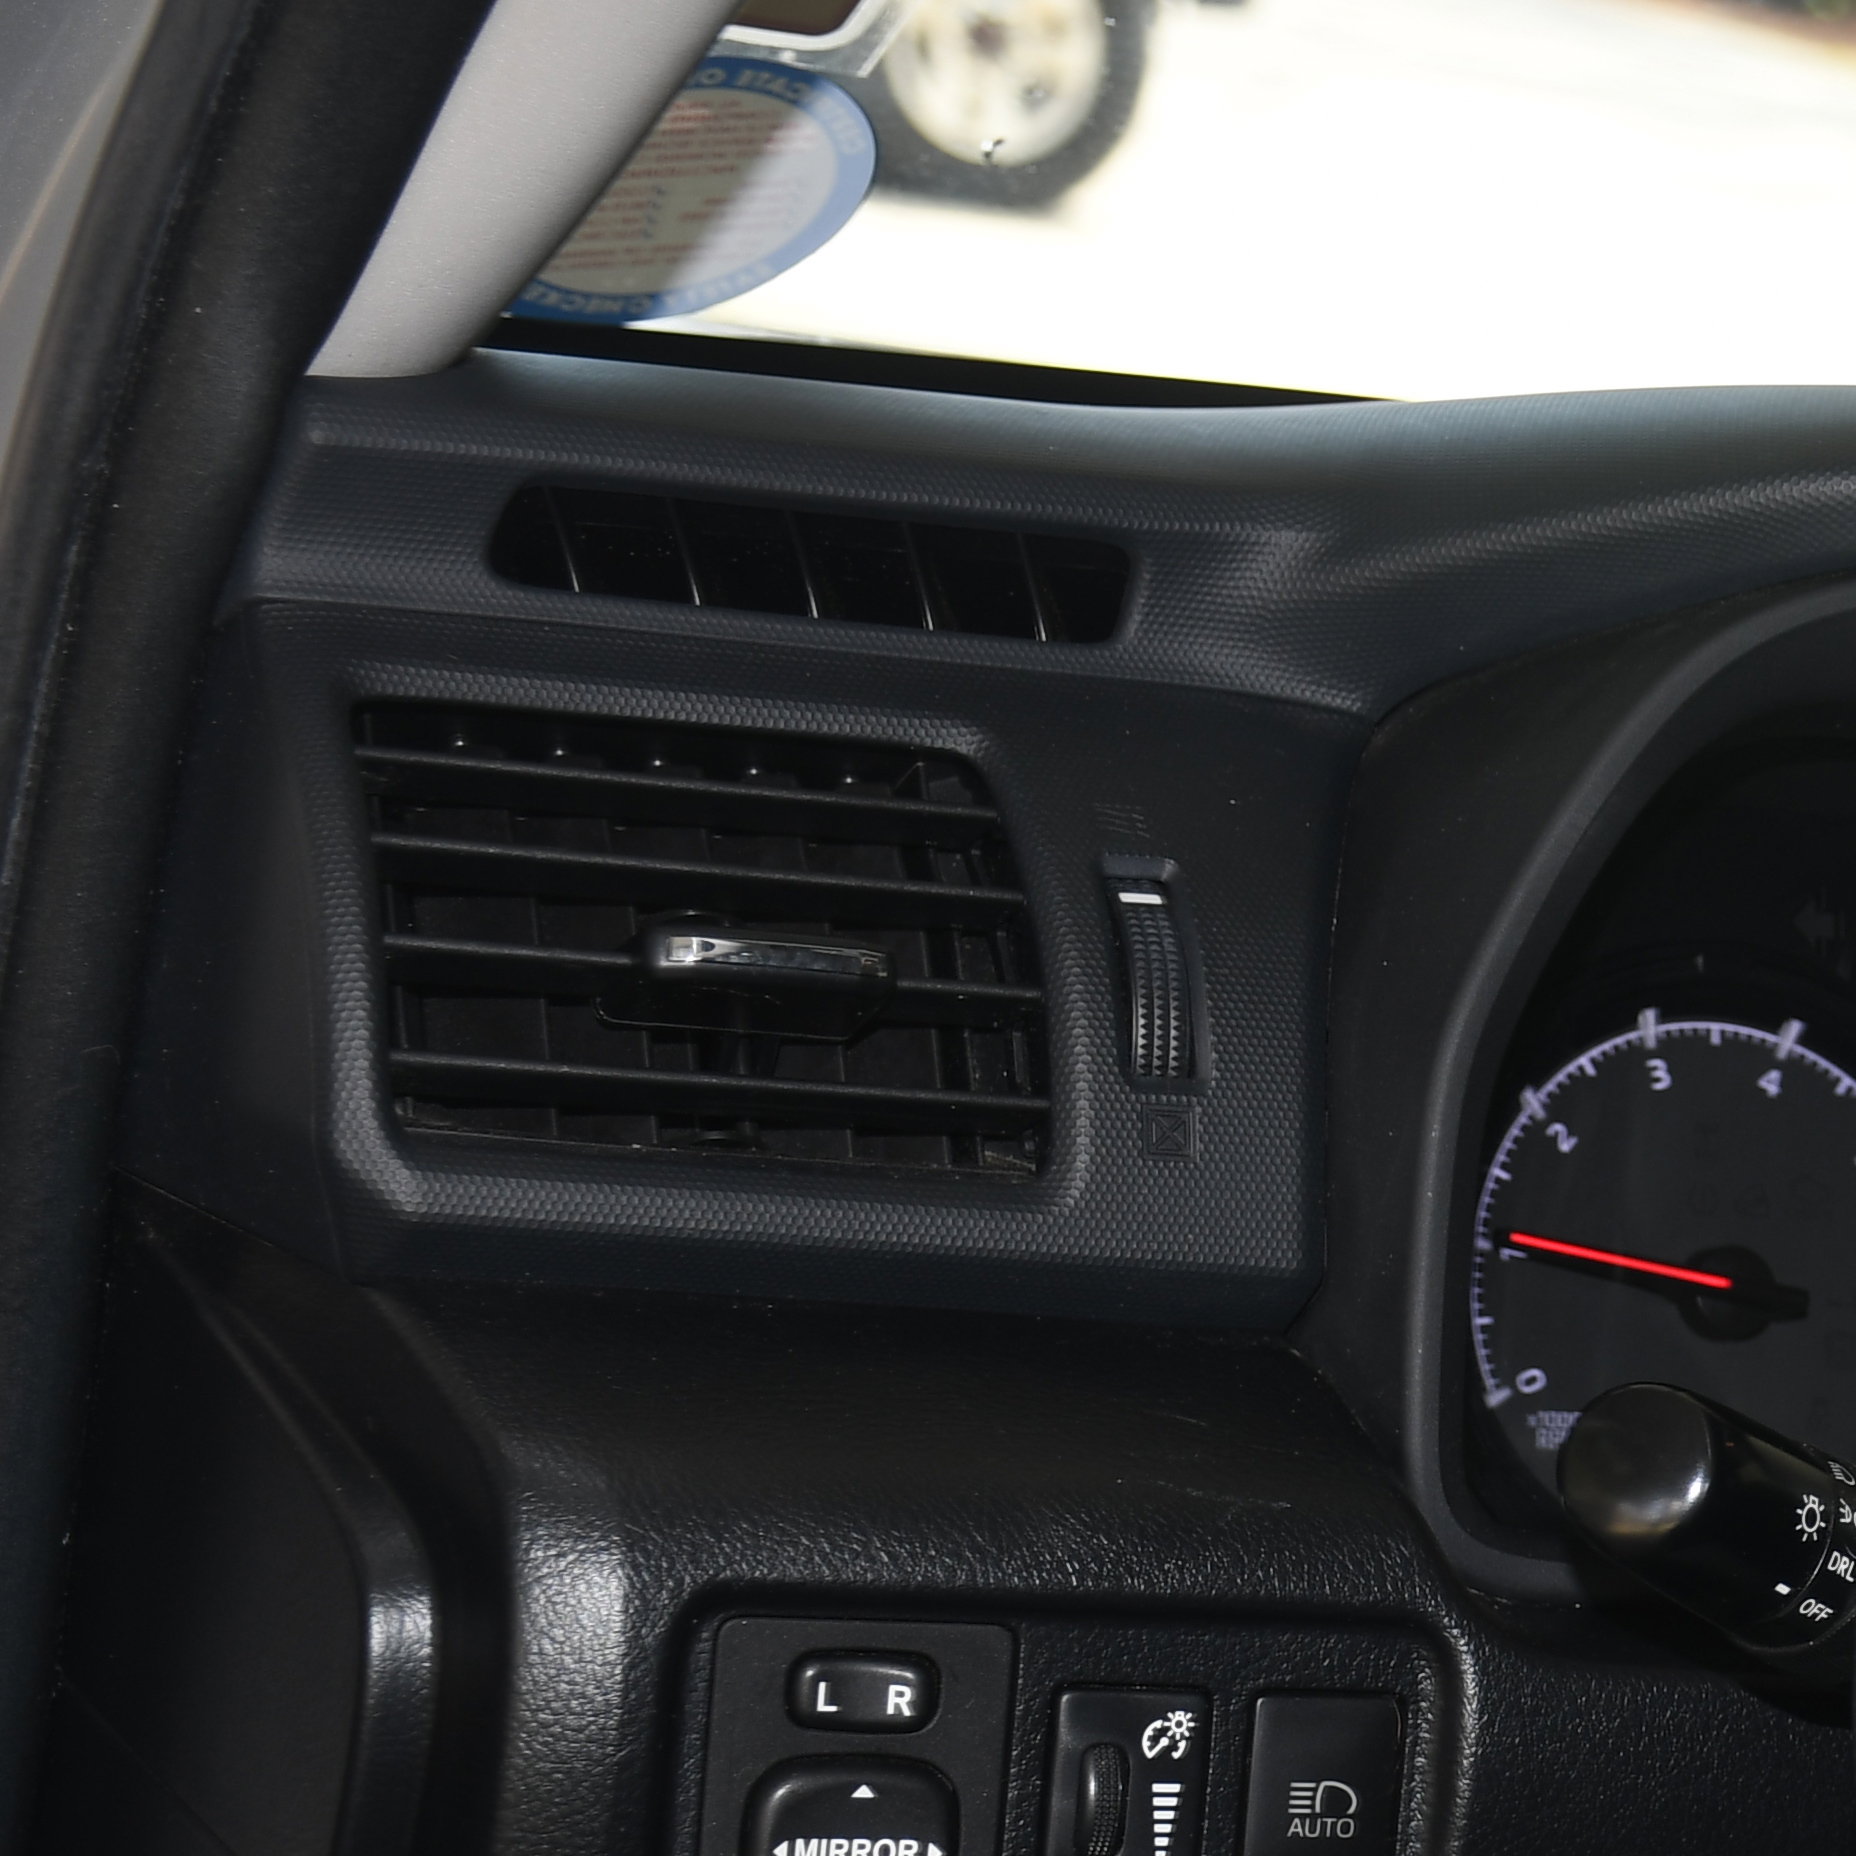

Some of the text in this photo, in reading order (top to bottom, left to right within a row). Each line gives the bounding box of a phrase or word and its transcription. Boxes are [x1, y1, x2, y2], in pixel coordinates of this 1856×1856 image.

[1644, 1058, 1673, 1091] 3
[1756, 1068, 1783, 1098] 4
[1546, 1122, 1578, 1153] 2
[1499, 1247, 1528, 1262] 1
[1515, 1367, 1548, 1394] 0
[1827, 1549, 1856, 1583] DRL
[1798, 1597, 1835, 1623] OFF
[816, 1682, 838, 1713] L
[886, 1686, 916, 1717] R
[1287, 1816, 1356, 1841] AUTO
